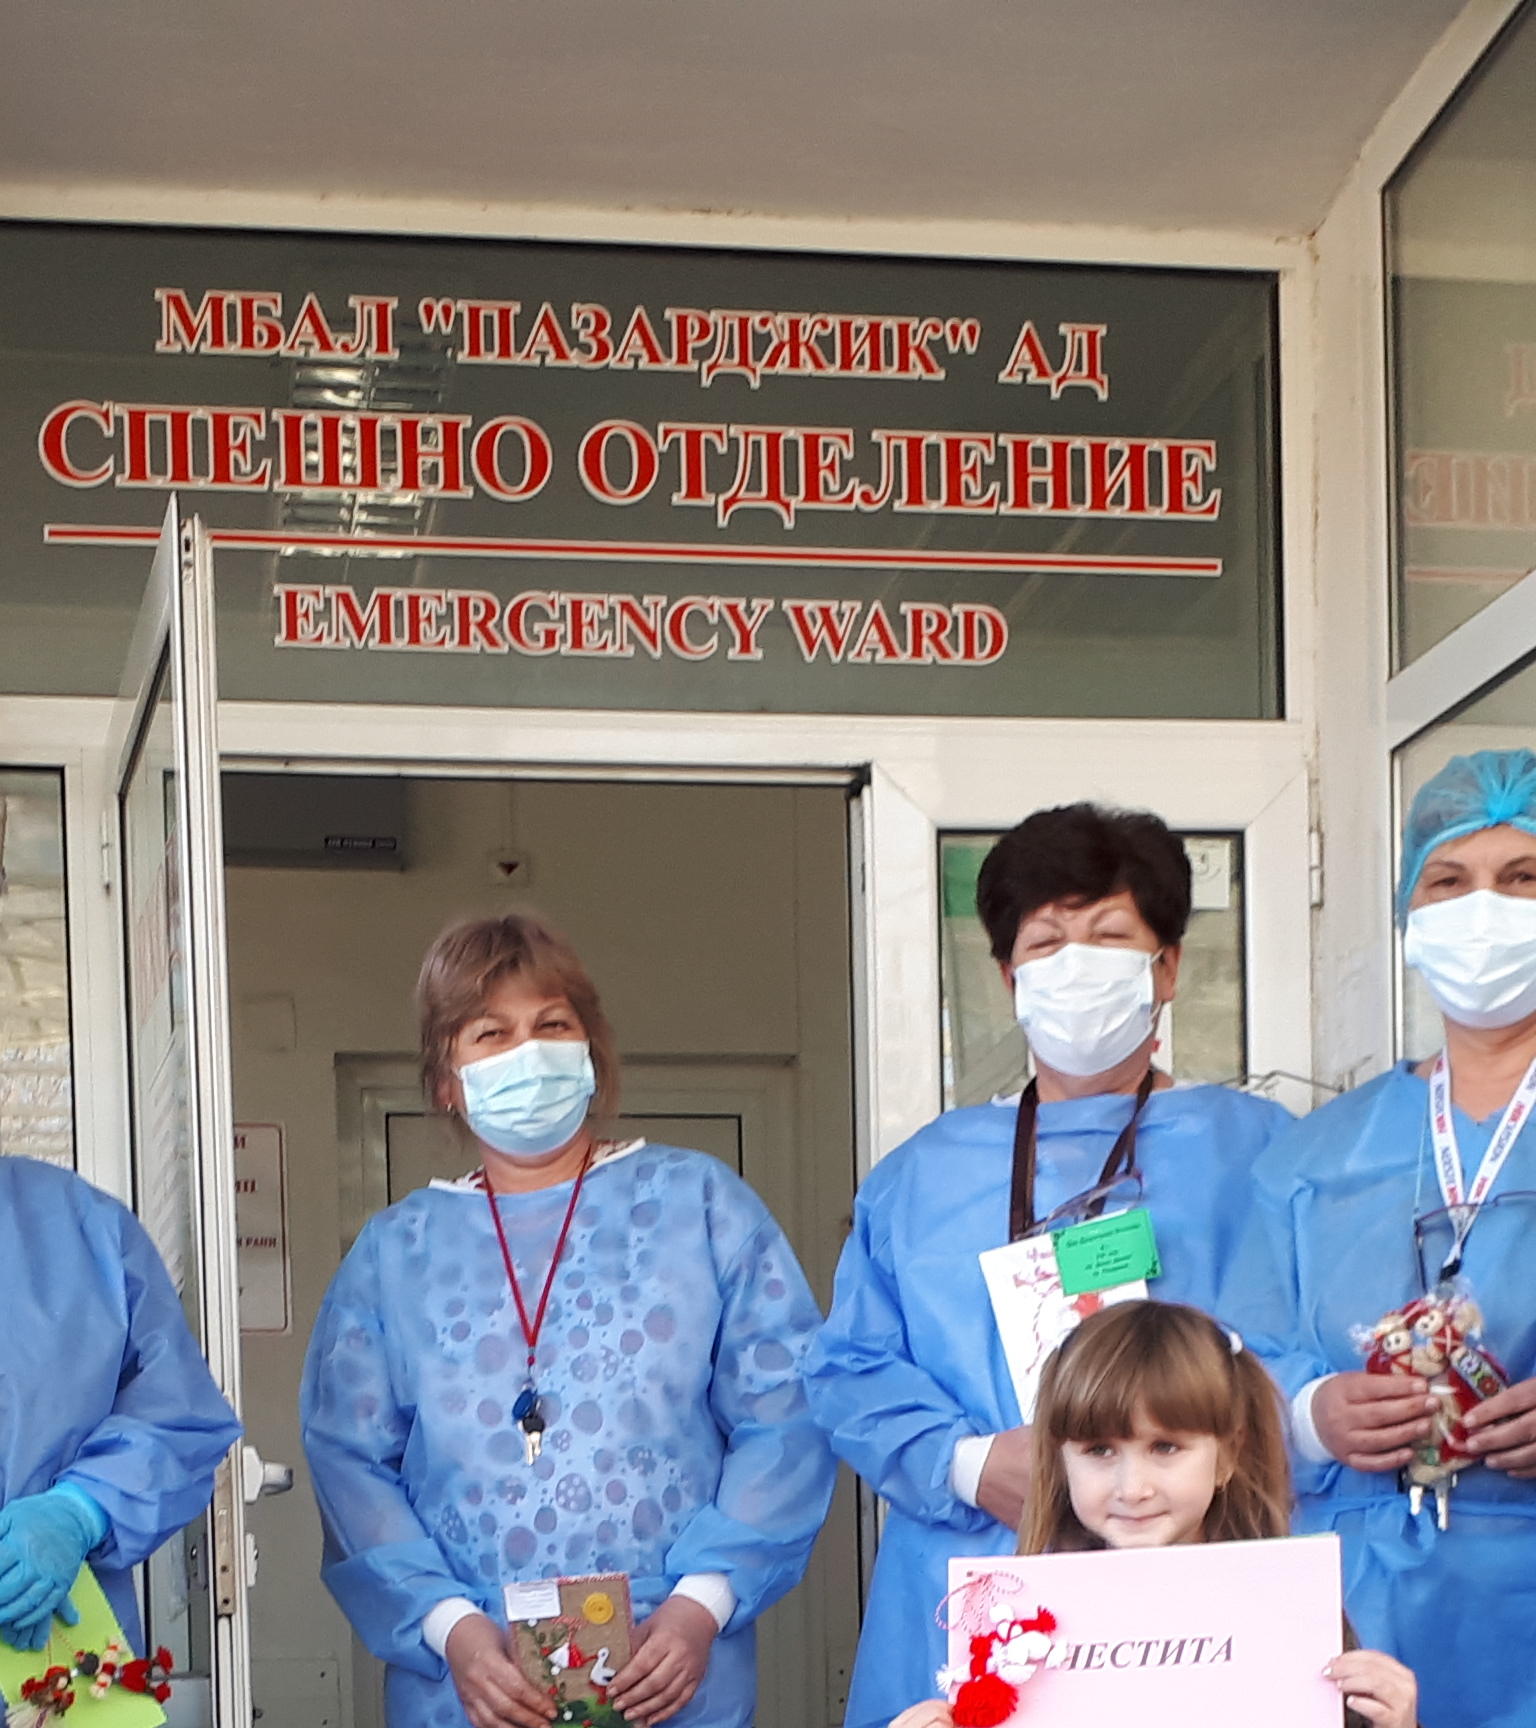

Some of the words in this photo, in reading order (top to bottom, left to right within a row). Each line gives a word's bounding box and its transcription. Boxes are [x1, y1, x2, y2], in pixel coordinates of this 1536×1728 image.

[154, 288, 399, 359] МБАЛ
[418, 297, 982, 389] "ПАЗАРДЖИК"
[998, 322, 1108, 400] АД
[38, 399, 552, 503] СПЕШНО
[578, 415, 1222, 529] ОТДЕЛЕНИЕ
[273, 584, 774, 662] EMERGENCY
[781, 598, 1009, 665] WARD
